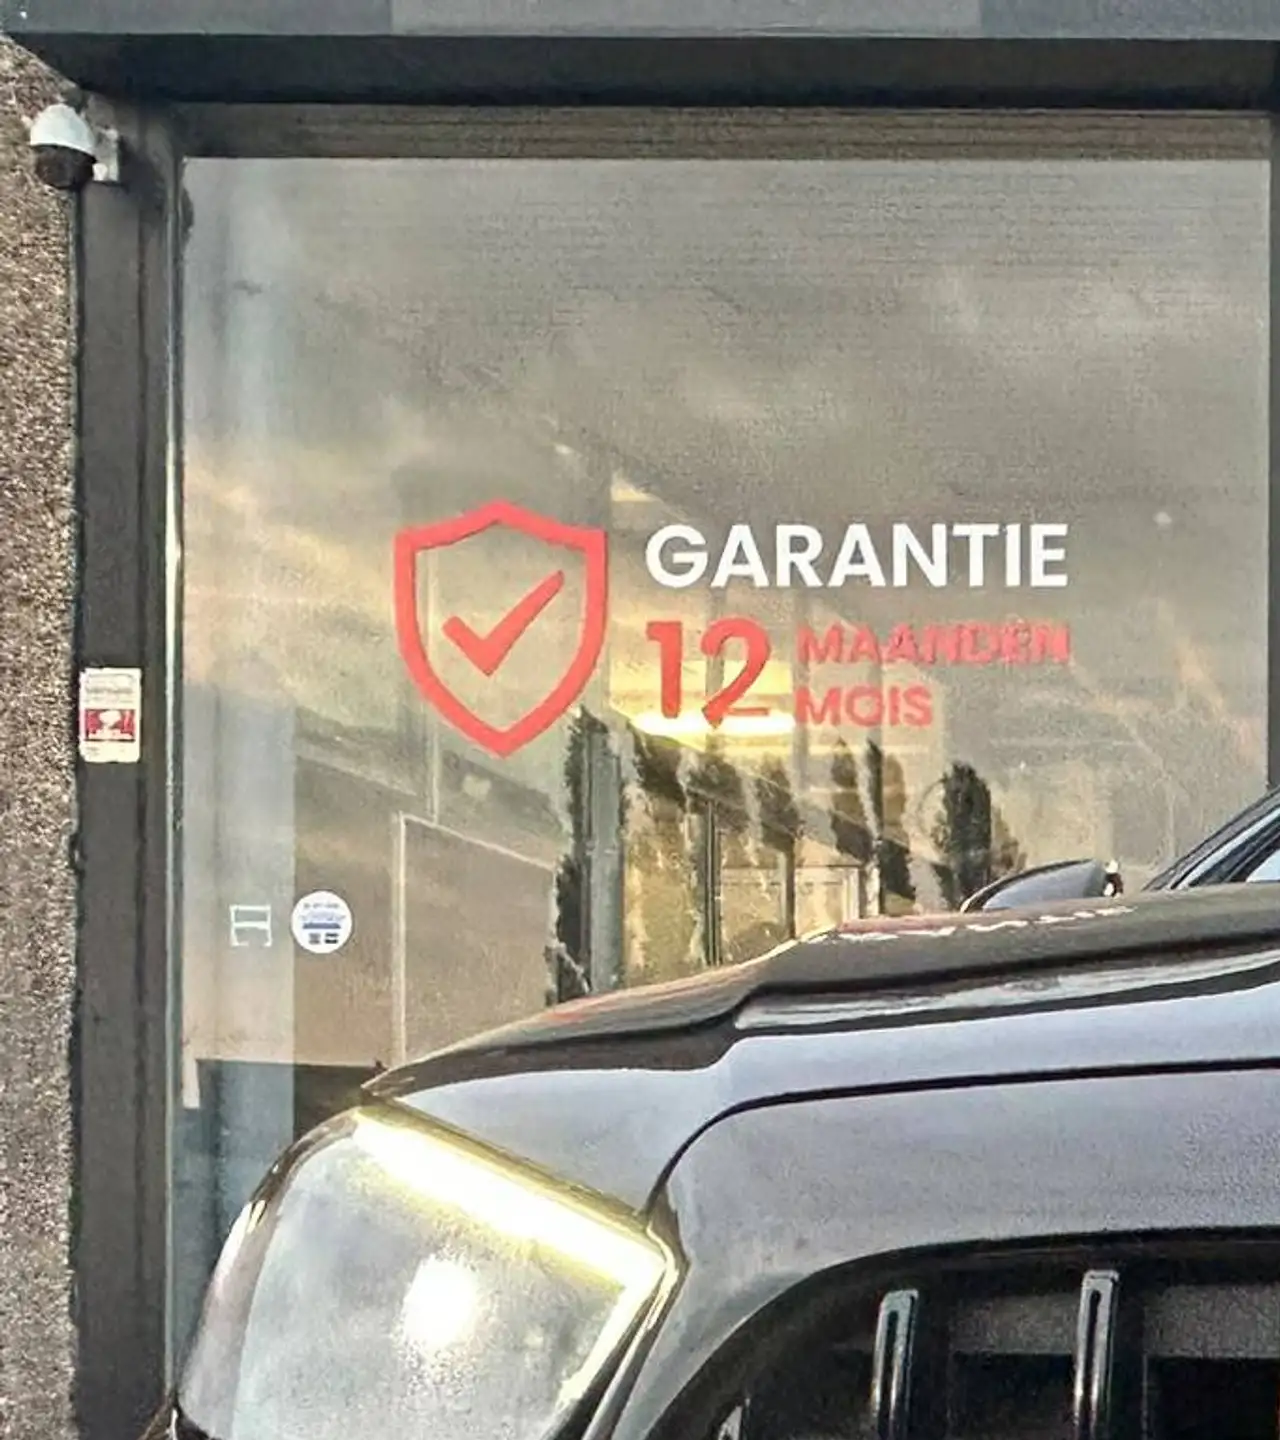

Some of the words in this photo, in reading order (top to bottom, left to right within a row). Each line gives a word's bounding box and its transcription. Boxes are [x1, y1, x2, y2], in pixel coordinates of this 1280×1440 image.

[645, 523, 1068, 588] GARANTIE
[794, 618, 1071, 664] MAANDEN
[645, 617, 772, 727] 12
[794, 684, 933, 727] MOIS
